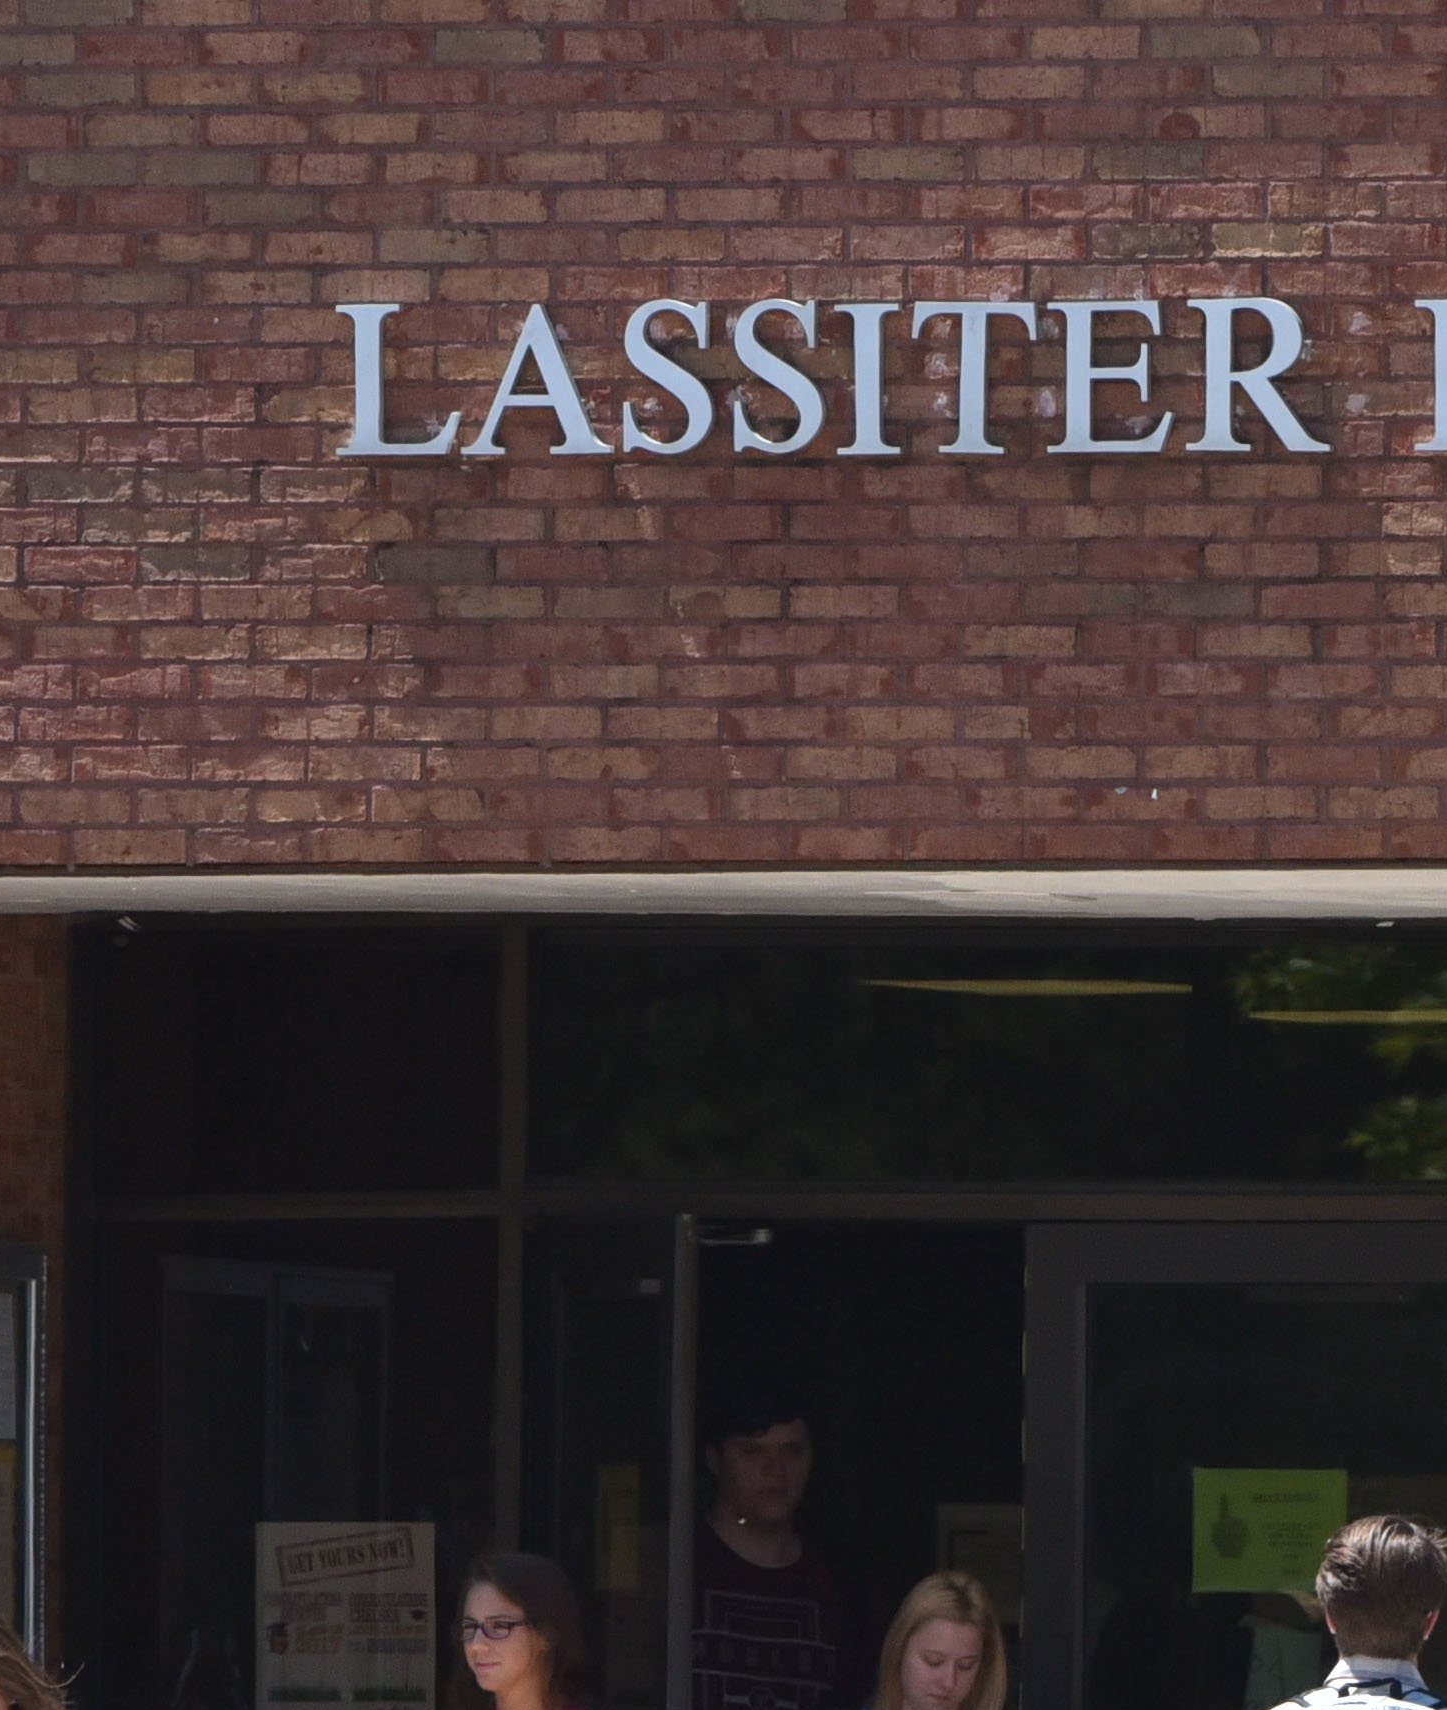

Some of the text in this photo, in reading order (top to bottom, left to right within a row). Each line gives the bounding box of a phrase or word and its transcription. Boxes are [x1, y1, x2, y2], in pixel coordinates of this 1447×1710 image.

[335, 298, 1331, 456] LASSITER
[287, 1537, 404, 1575] GET YOURS NOW!
